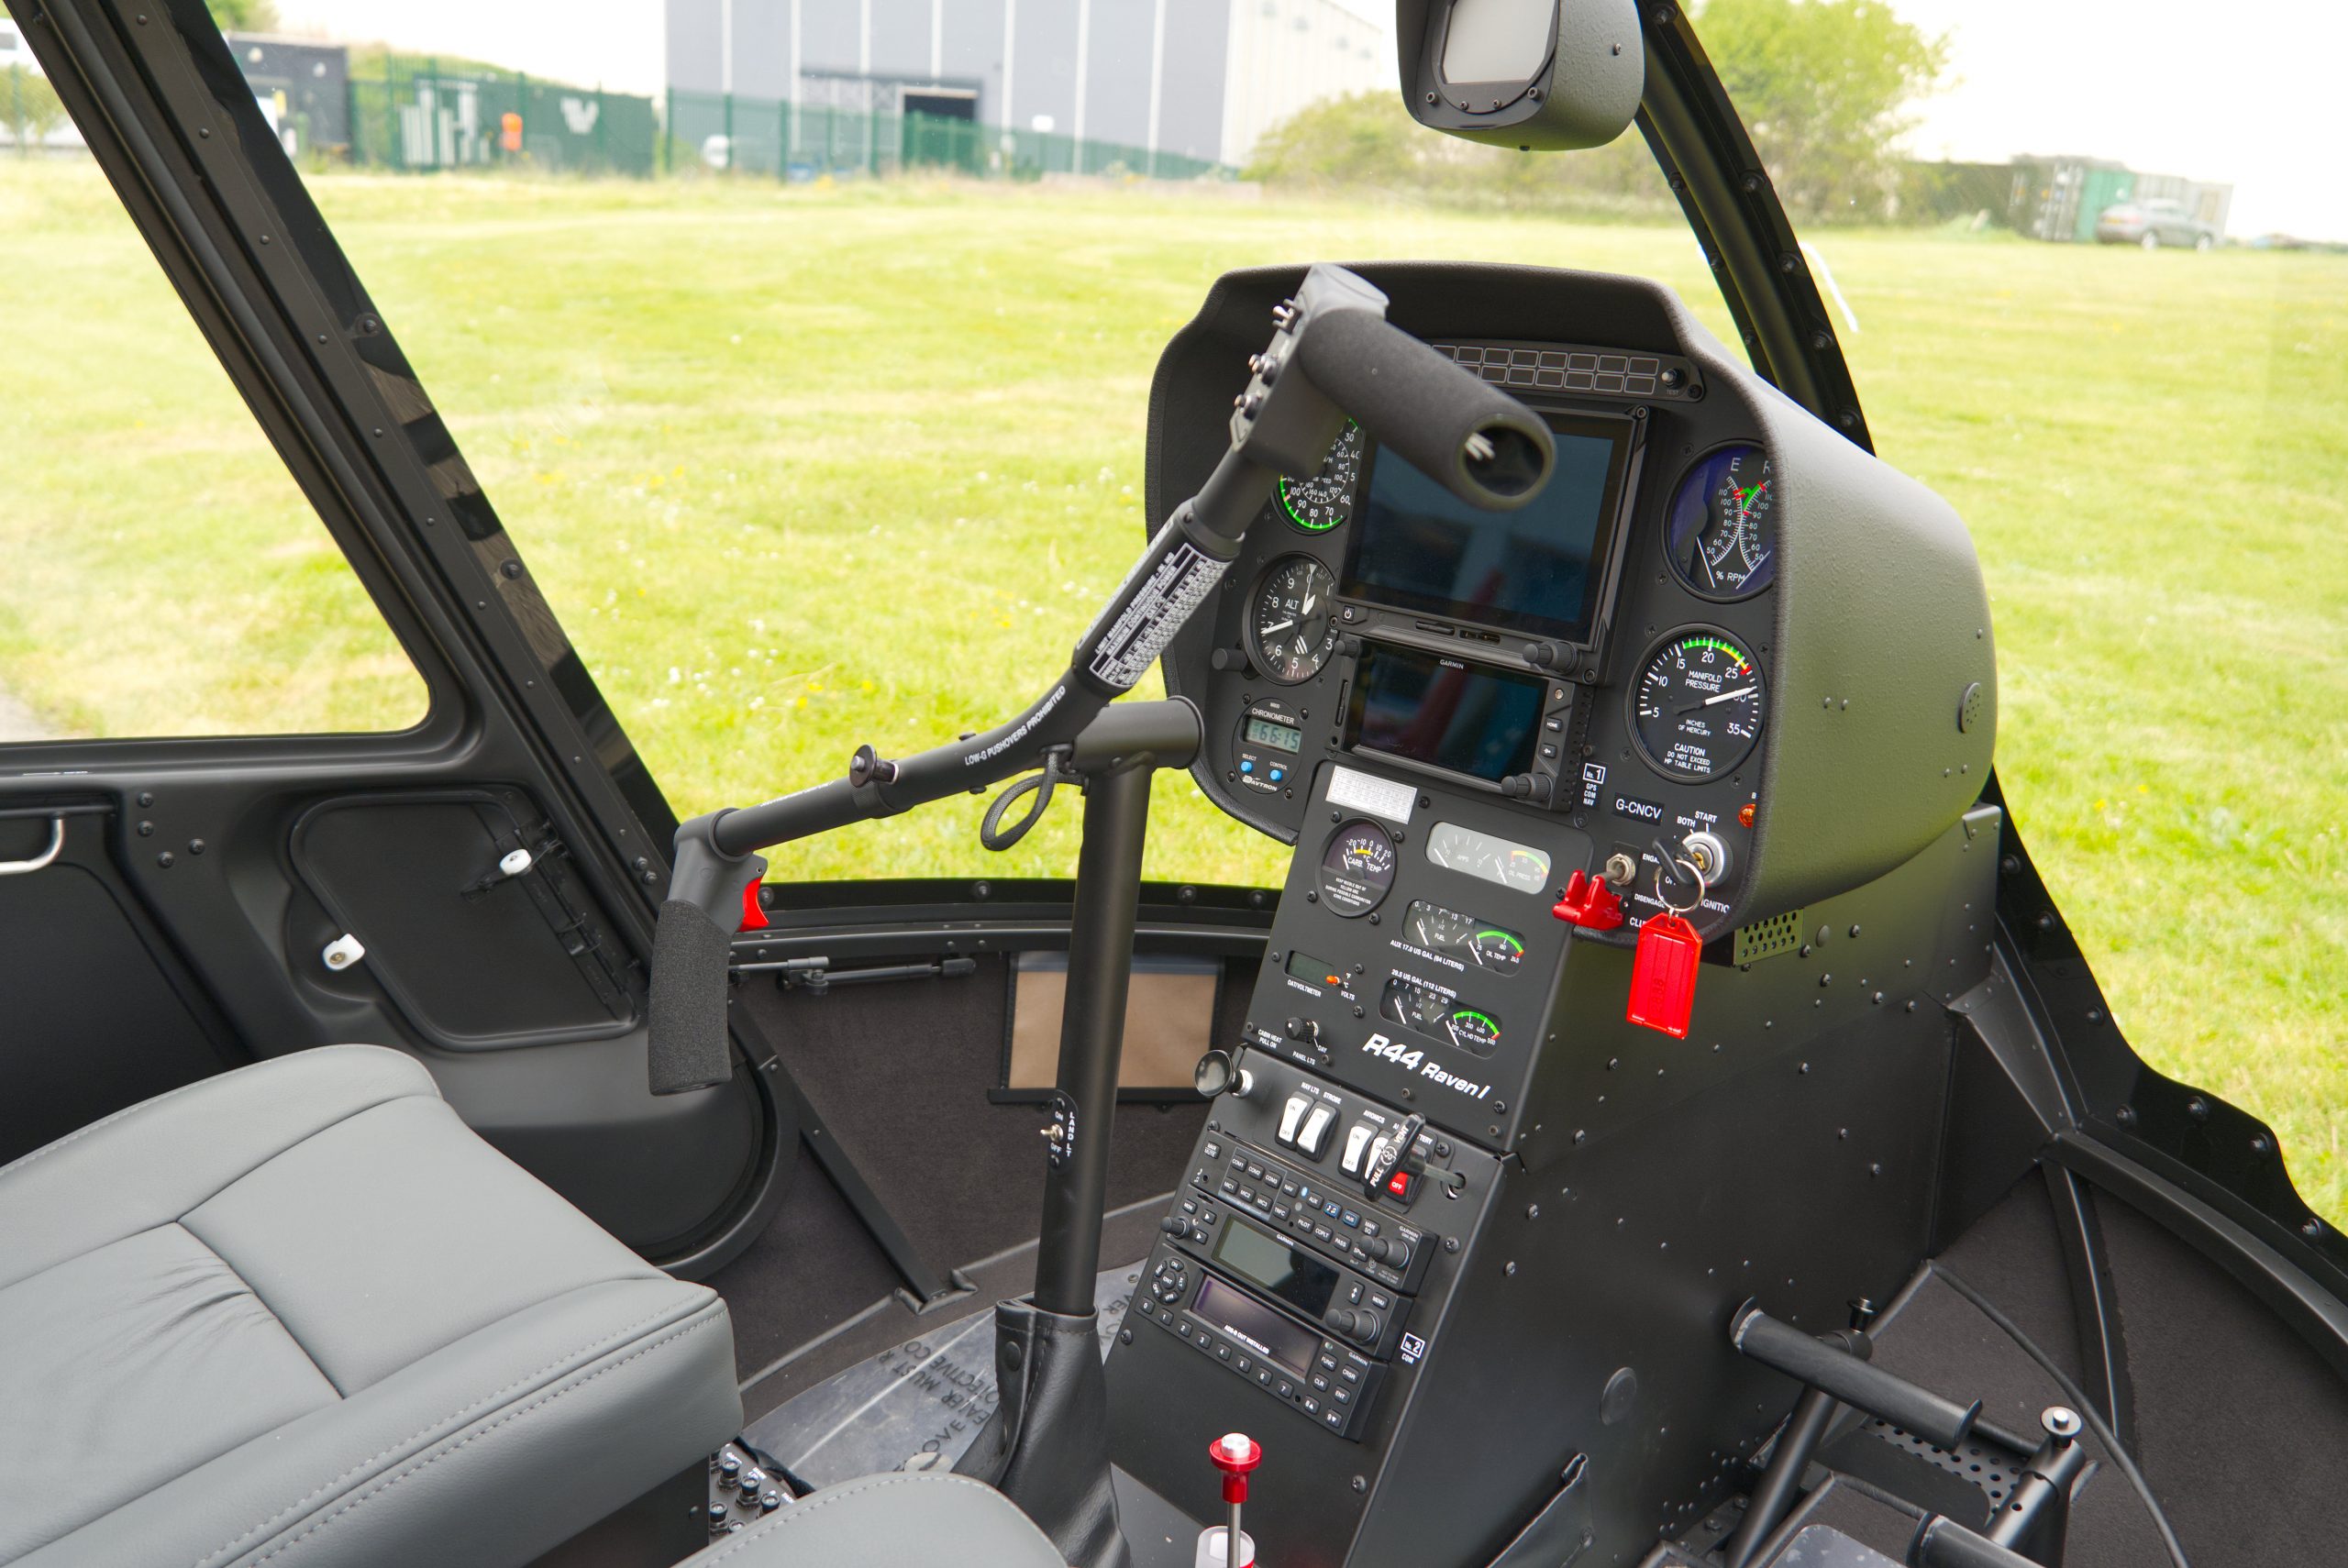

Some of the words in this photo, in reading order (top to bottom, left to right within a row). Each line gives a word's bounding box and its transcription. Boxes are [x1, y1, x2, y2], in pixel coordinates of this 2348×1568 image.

[1344, 432, 1354, 444] 30
[1730, 458, 1741, 471] E
[1290, 486, 1301, 497] 100
[1297, 499, 1306, 510] 90
[1340, 494, 1349, 504] 60
[1721, 498, 1732, 506] 100
[1324, 506, 1335, 517] 70
[1758, 502, 1768, 510] 100
[1309, 508, 1318, 519] 80
[1723, 508, 1733, 516] 90
[1752, 512, 1762, 520] 90
[1723, 519, 1732, 527] 80
[1749, 522, 1758, 530] 80
[1720, 530, 1729, 538] 70
[1749, 533, 1757, 542] 70
[1713, 538, 1722, 547] 60
[1751, 543, 1760, 552] 60
[1706, 547, 1715, 556] 50
[1755, 553, 1764, 561] 50
[1727, 572, 1745, 582] RPM
[1287, 578, 1295, 590] 9
[1129, 574, 1157, 609] PRESSURE
[1271, 597, 1279, 608] 8
[1285, 598, 1299, 610] ALT
[1105, 626, 1130, 657] MAXIMUM
[1127, 588, 1160, 629] CONTINUOUS
[1157, 565, 1178, 591] POWER
[1325, 638, 1333, 650] 3
[1275, 645, 1282, 657] 6
[1291, 657, 1299, 669] 5
[1676, 657, 1686, 669] 15
[1701, 652, 1714, 664] 20
[1440, 659, 1464, 670] GARMIN
[1688, 669, 1722, 683] MANIFOLD
[1724, 667, 1738, 679] 25
[1658, 675, 1668, 687] 10
[1685, 679, 1721, 693] PRESSURE
[1251, 707, 1294, 724] CHRONOMETER
[1652, 707, 1659, 718] 5
[965, 750, 987, 767] LOW-G
[987, 723, 1028, 758] PUSHOVERS
[1026, 685, 1067, 732] PROHIBITED
[1546, 721, 1557, 729] HOME
[1686, 719, 1706, 728] INCHES
[1726, 722, 1741, 735] 35
[1686, 726, 1711, 737] MERCURY
[1674, 743, 1706, 756] CAUTION
[1667, 750, 1675, 758] DO
[1677, 753, 1689, 761] NOT
[1689, 755, 1711, 766] EXCEED
[1269, 760, 1288, 771] CONTROL
[1674, 759, 1692, 770] TABLE
[1694, 763, 1711, 773] LIMITS
[1596, 768, 1601, 780] 1
[1242, 774, 1278, 791] DAVTRON
[1586, 782, 1597, 791] GPS
[1583, 790, 1596, 799] COM
[1583, 798, 1594, 806] NAV
[1615, 798, 1662, 820] G-CNCV
[1677, 816, 1696, 827] BOTH
[1694, 811, 1717, 823] START
[1346, 838, 1357, 846] -20
[1383, 849, 1391, 858] 20
[1643, 853, 1659, 864] ENGA
[1367, 862, 1382, 873] TEMP
[1700, 898, 1730, 913] IGNITIO
[1451, 912, 1458, 921] 13
[1434, 933, 1445, 942] FUEL
[1390, 939, 1401, 949] AUX
[1413, 947, 1422, 955] US
[1422, 950, 1434, 960] GAL
[1442, 957, 1465, 972] LITERS)
[1493, 952, 1507, 962] TEMP
[1287, 978, 1322, 998] OAT/VOLTMETER
[1402, 973, 1412, 981] US
[1411, 976, 1423, 987] GAL
[1423, 980, 1434, 990] (112
[1434, 984, 1456, 999] LITERS)
[1414, 987, 1421, 995] 15
[1340, 990, 1356, 1001] VOLTS
[1428, 992, 1436, 1000] 23
[1412, 1010, 1423, 1021] FUEL
[1257, 1029, 1270, 1040] CABIN
[1269, 1033, 1282, 1043] HEAT
[1259, 1037, 1270, 1046] PULL
[1473, 1034, 1487, 1044] TEMP
[1317, 1043, 1327, 1054] DAY
[1292, 1051, 1306, 1063] PANEL
[1306, 1056, 1315, 1066] LTS
[1362, 1032, 1423, 1070] R44
[1421, 1061, 1481, 1097] Raven
[1301, 1081, 1312, 1091] NAV
[1310, 1087, 1319, 1095] LTS
[1323, 1091, 1342, 1105] STROBE
[1055, 1110, 1064, 1121] ON
[1363, 1110, 1386, 1124] AVIONICS
[1067, 1111, 1075, 1141] LAND
[1394, 1124, 1410, 1143] VENT
[1050, 1143, 1062, 1154] OFF
[1066, 1143, 1072, 1157] LT
[1232, 1158, 1244, 1167] COM1
[1248, 1165, 1261, 1176] COM2
[1265, 1174, 1278, 1185] COM3
[1369, 1168, 1384, 1187] PULL
[1224, 1181, 1235, 1190] MIC1
[1284, 1184, 1293, 1193] NAV
[1391, 1181, 1403, 1190] OFF
[1240, 1189, 1251, 1199] MIC2
[1183, 1201, 1193, 1210] MON
[1257, 1197, 1268, 1207] MIC3
[1308, 1196, 1318, 1205] AUX
[1274, 1207, 1286, 1217] TRFC
[1297, 1219, 1311, 1229] PILOT
[1364, 1220, 1376, 1230] MAN
[1314, 1227, 1329, 1238] COPLT
[1399, 1225, 1419, 1239] GARMIN
[1277, 1234, 1294, 1246] GARMIN
[1335, 1238, 1346, 1248] PASS
[1372, 1296, 1385, 1306] MENU
[1246, 1338, 1270, 1354] INSTALLED
[1412, 1341, 1421, 1353] 2
[1321, 1355, 1335, 1368] FUNC
[1348, 1352, 1368, 1366] GARMIN
[1401, 1353, 1414, 1364] COM
[892, 1357, 940, 1394] MUST
[1342, 1367, 1356, 1380] CRSR
[928, 1354, 1002, 1407] OTECTIVE
[1314, 1377, 1324, 1387] CLR
[1335, 1389, 1346, 1400] ENT
